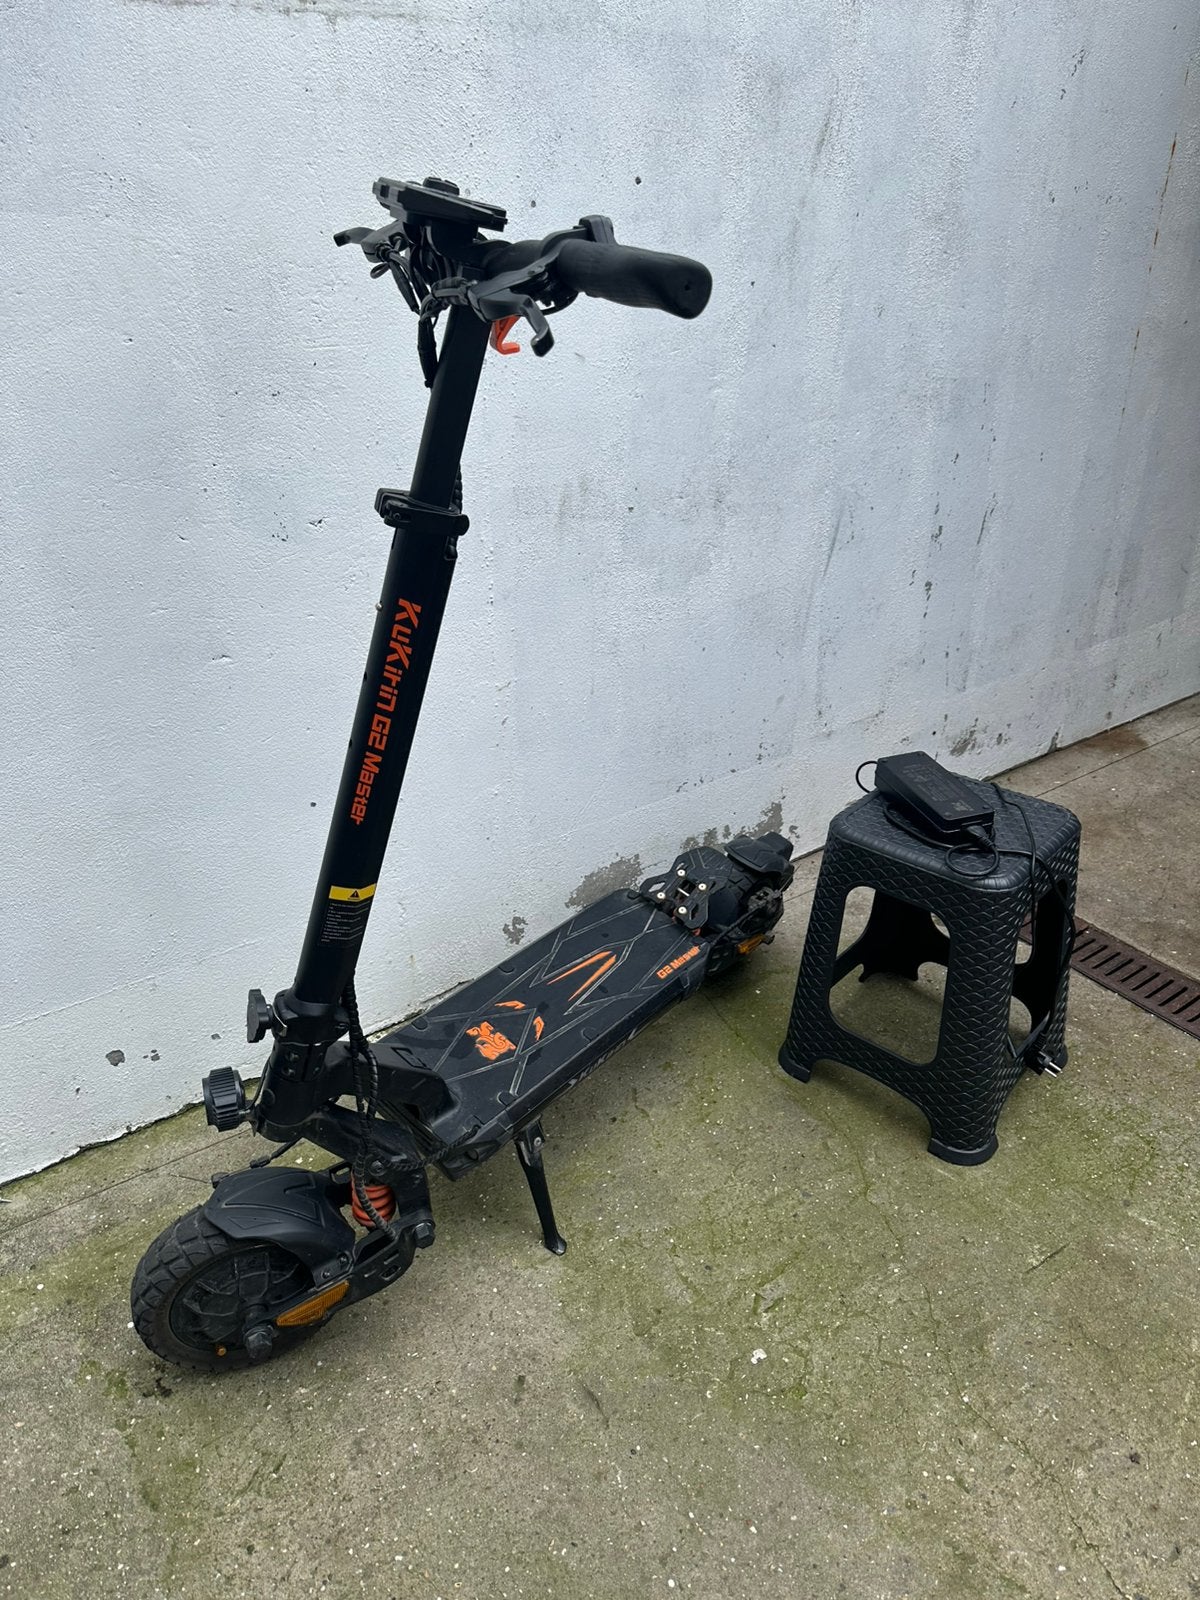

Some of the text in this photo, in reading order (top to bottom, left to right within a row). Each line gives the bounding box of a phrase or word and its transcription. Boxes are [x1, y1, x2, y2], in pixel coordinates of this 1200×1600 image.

[351, 599, 422, 824] KuKirin G2 Master
[656, 964, 674, 980] G2
